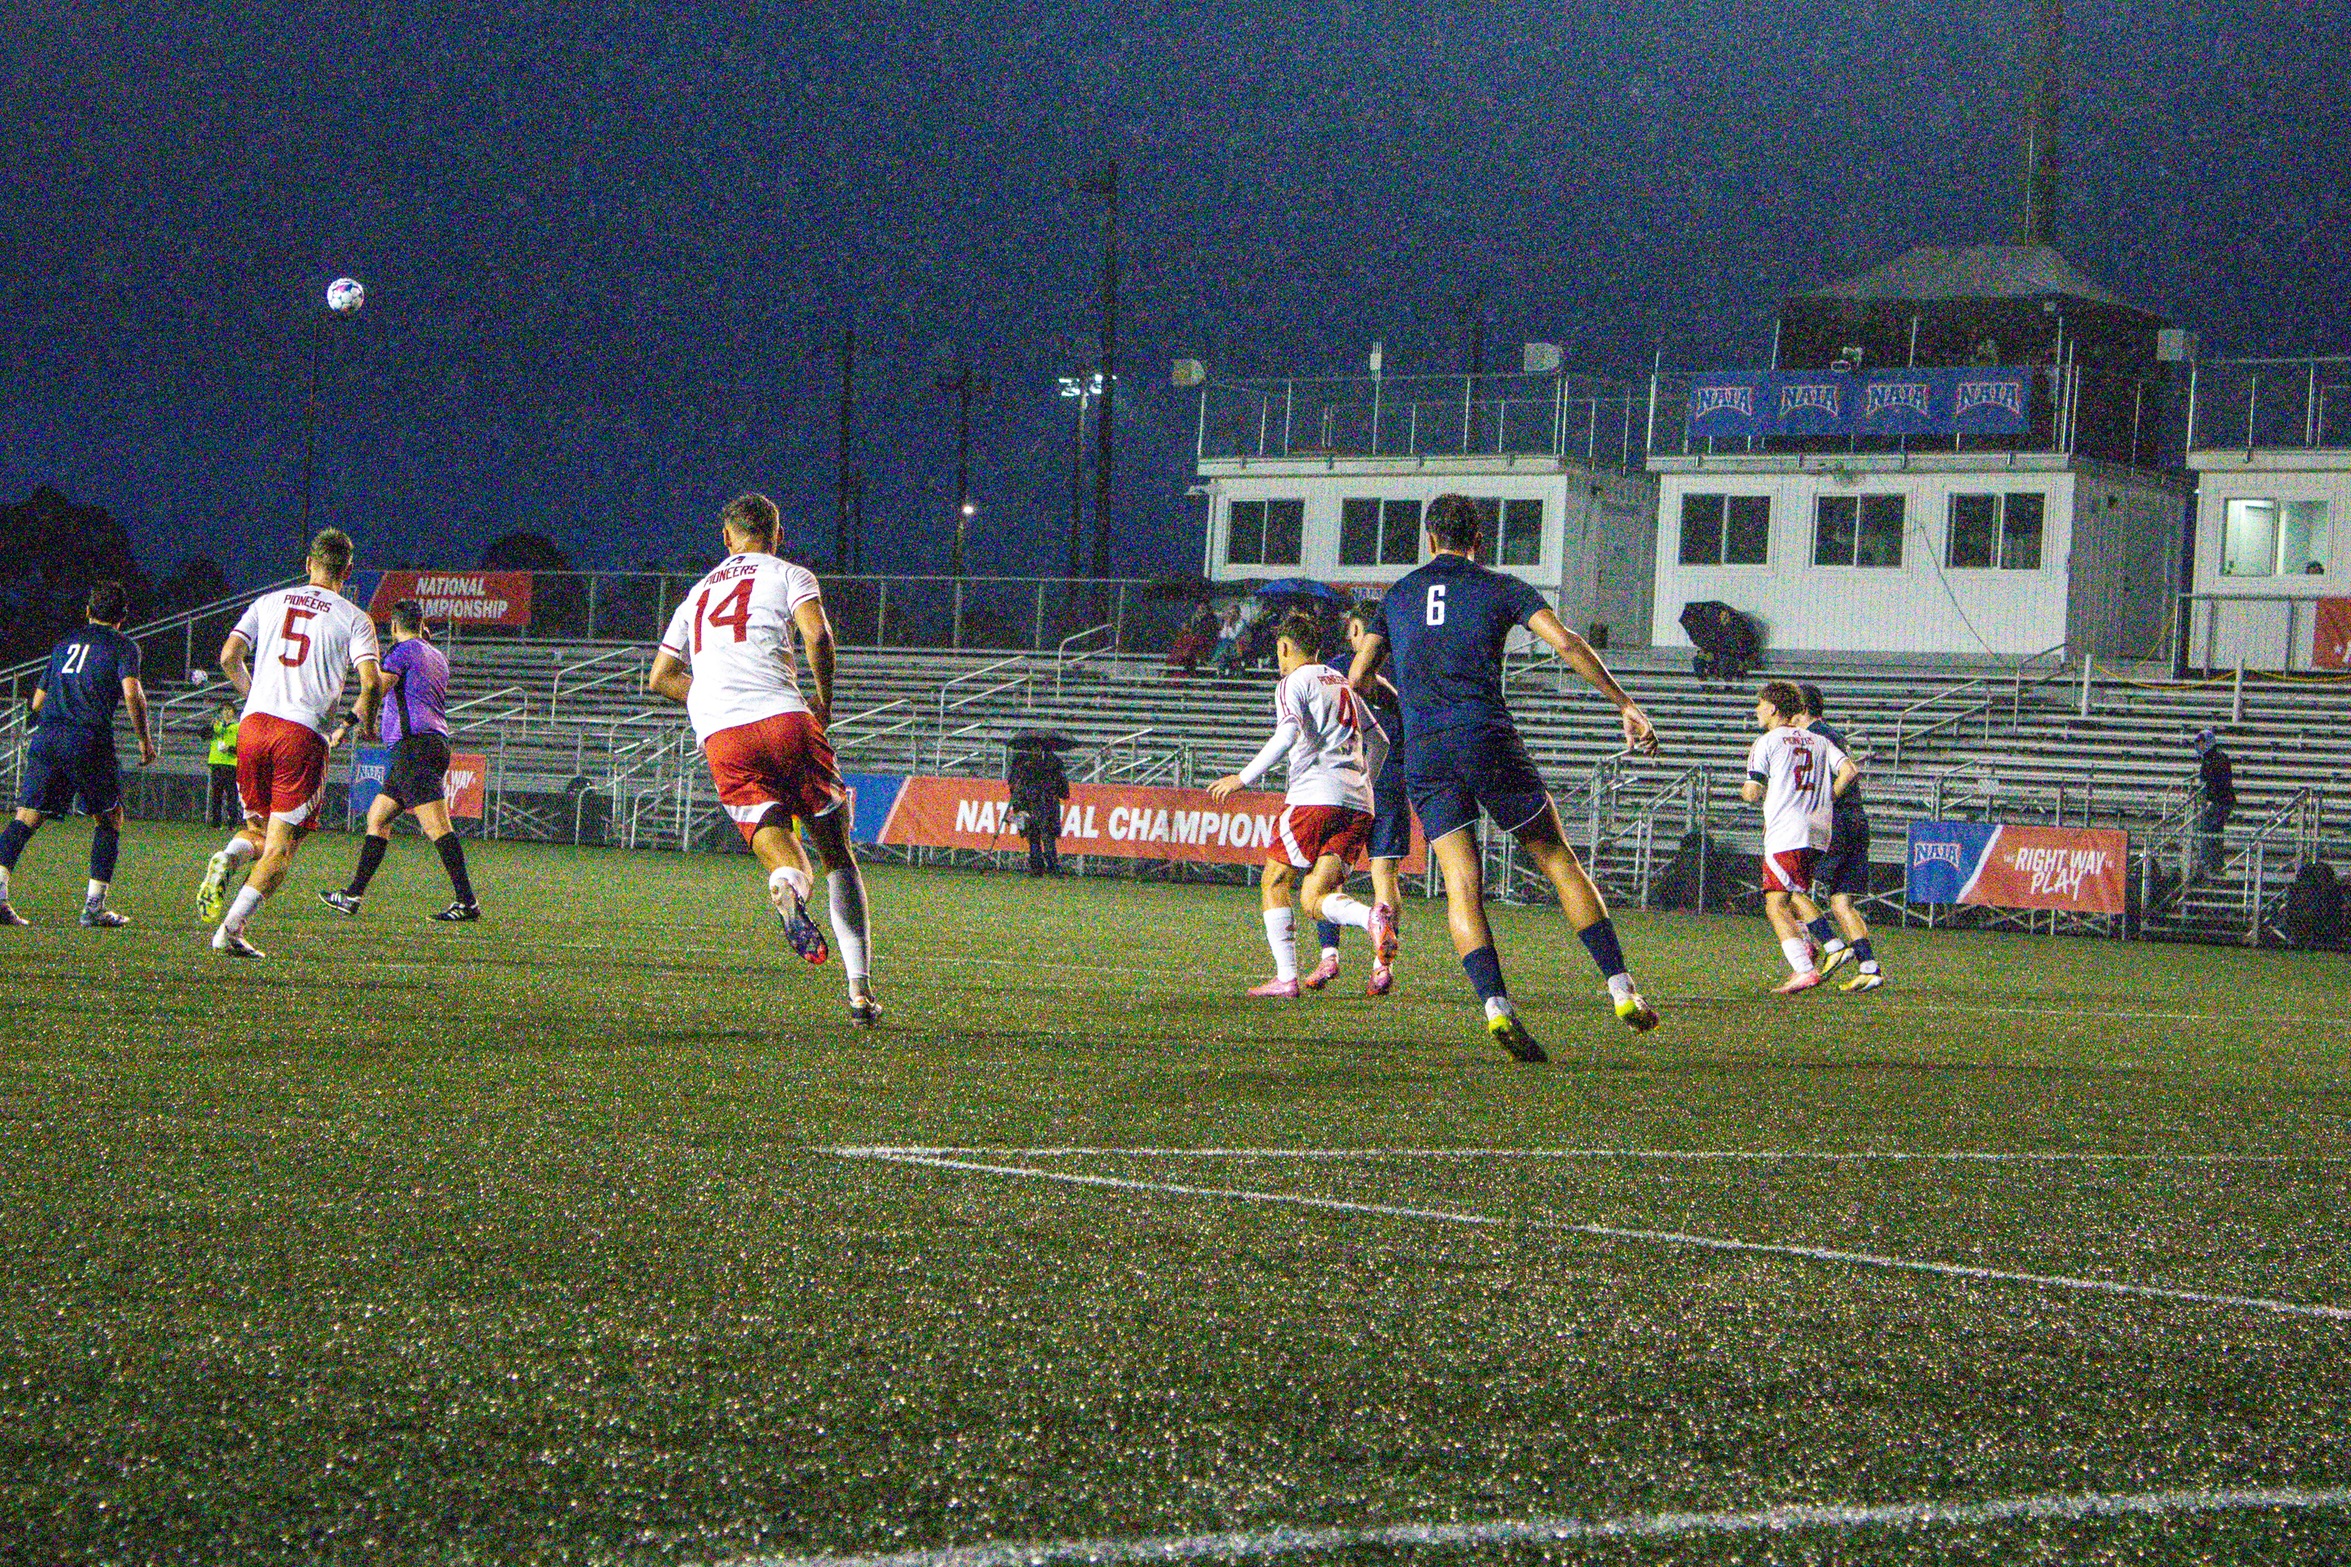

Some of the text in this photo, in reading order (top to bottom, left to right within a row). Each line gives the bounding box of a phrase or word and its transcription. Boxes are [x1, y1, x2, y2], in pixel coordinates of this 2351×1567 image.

[415, 577, 485, 596] NATIONAL
[703, 564, 759, 588] PIONEERS
[283, 594, 333, 613] PIONEERS
[694, 578, 755, 655] 14
[1426, 584, 1446, 626] 6
[278, 606, 318, 668] 5
[61, 643, 91, 674] 21
[1792, 747, 1815, 791] 2
[955, 799, 1100, 839] NATAL
[1914, 842, 1961, 871] NAIA
[2014, 846, 2107, 875] RIGHT WAY
[2030, 868, 2084, 901] PLAY
